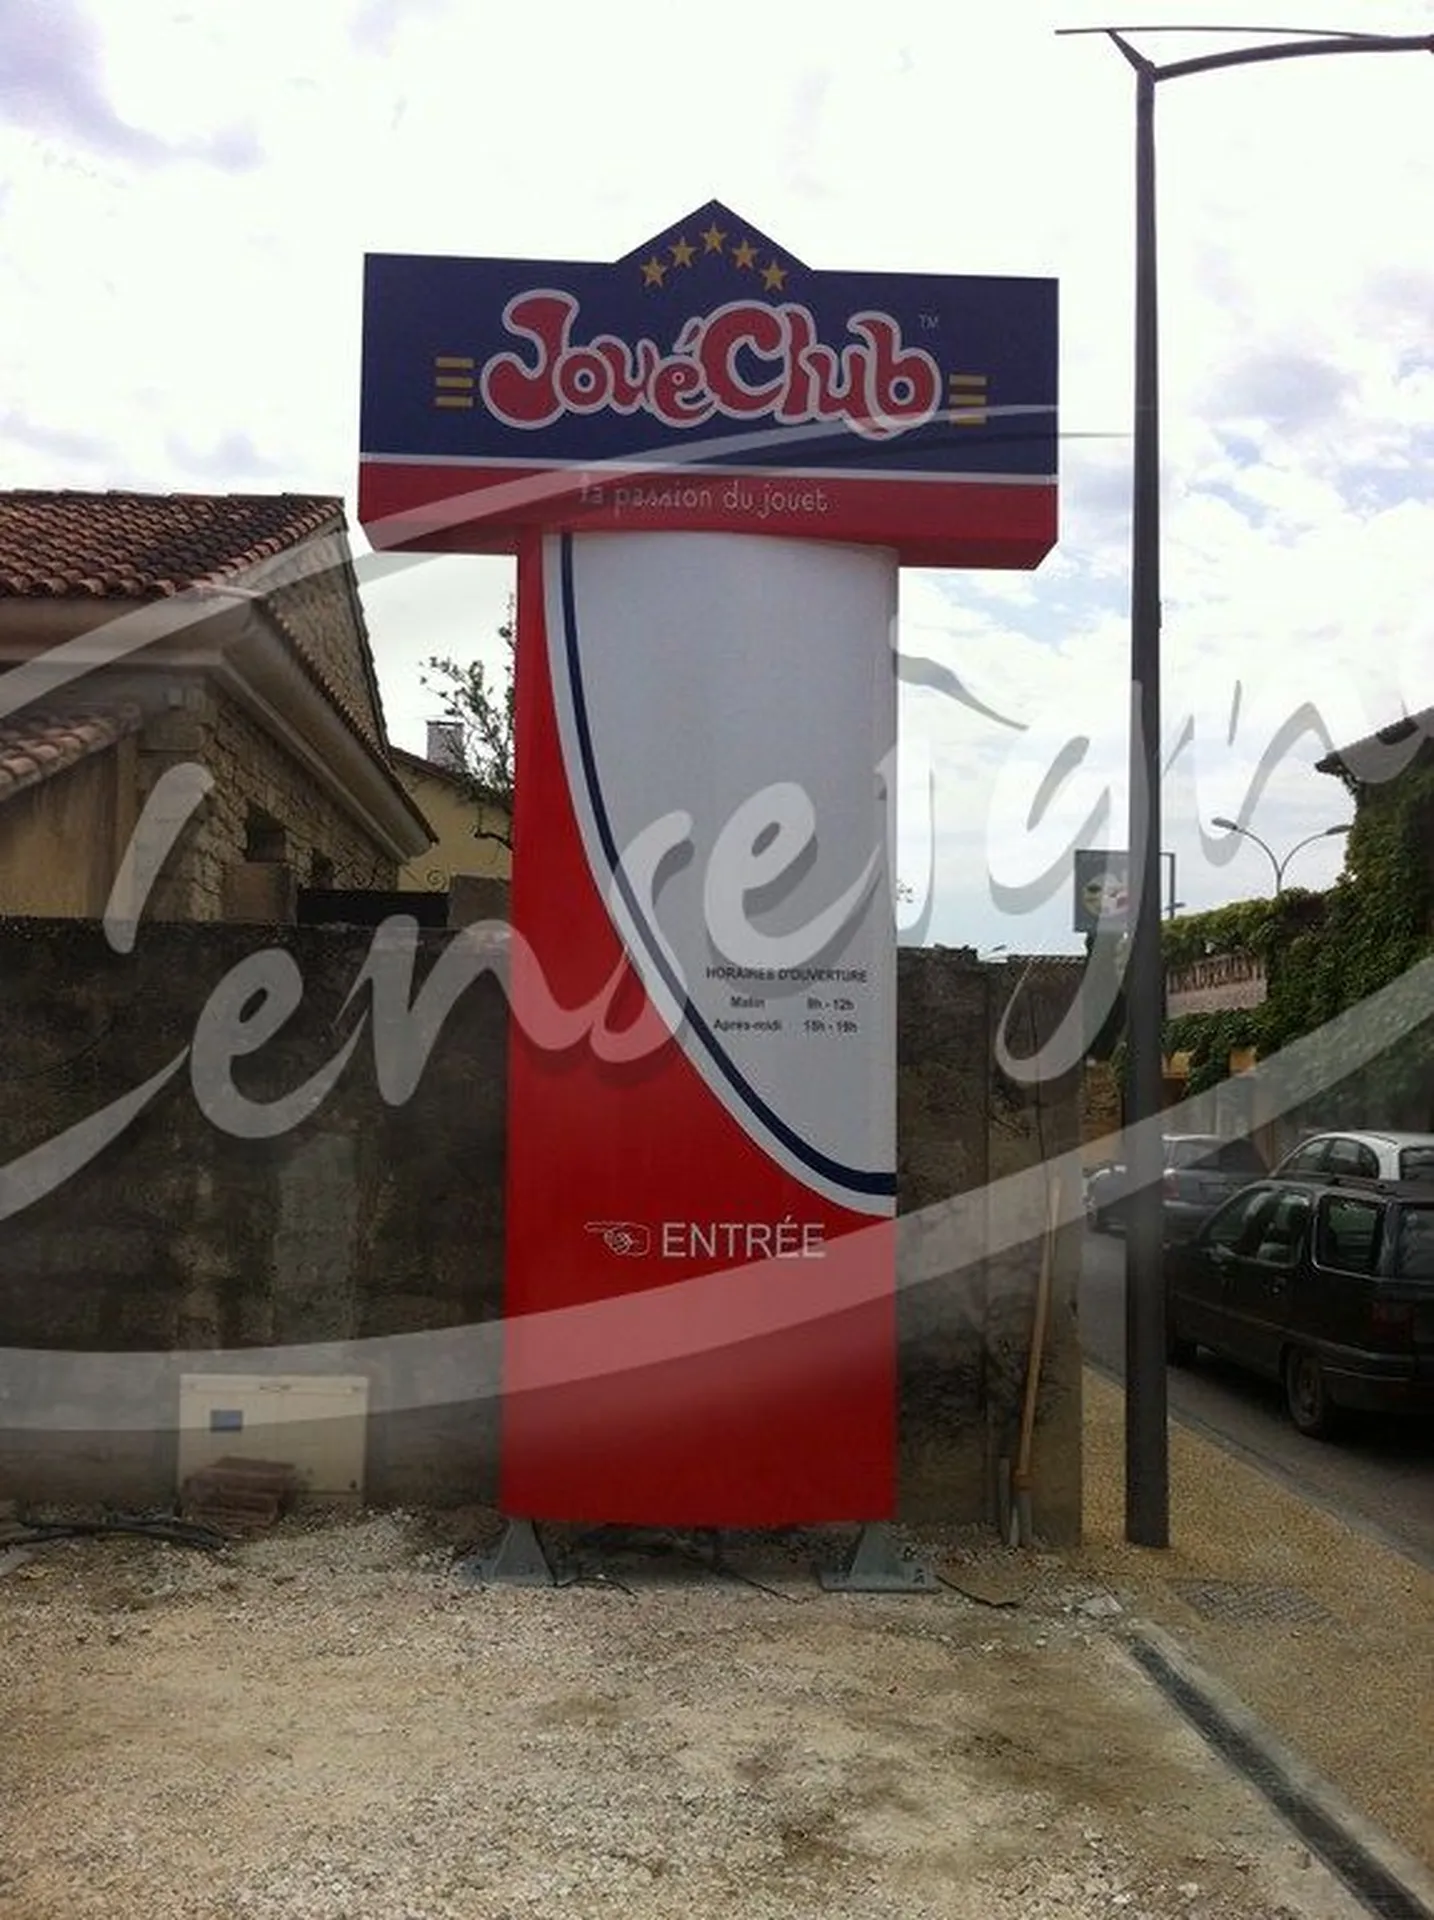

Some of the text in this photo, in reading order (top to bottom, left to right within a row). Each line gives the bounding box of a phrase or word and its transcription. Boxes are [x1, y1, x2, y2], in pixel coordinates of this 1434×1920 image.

[480, 288, 943, 440] JouéClub
[615, 482, 712, 518] passion
[723, 480, 754, 511] du
[758, 484, 829, 519] jouet
[706, 966, 868, 984] HORAIRES D'OUVERTURE
[661, 1215, 826, 1258] ENTRÉE
